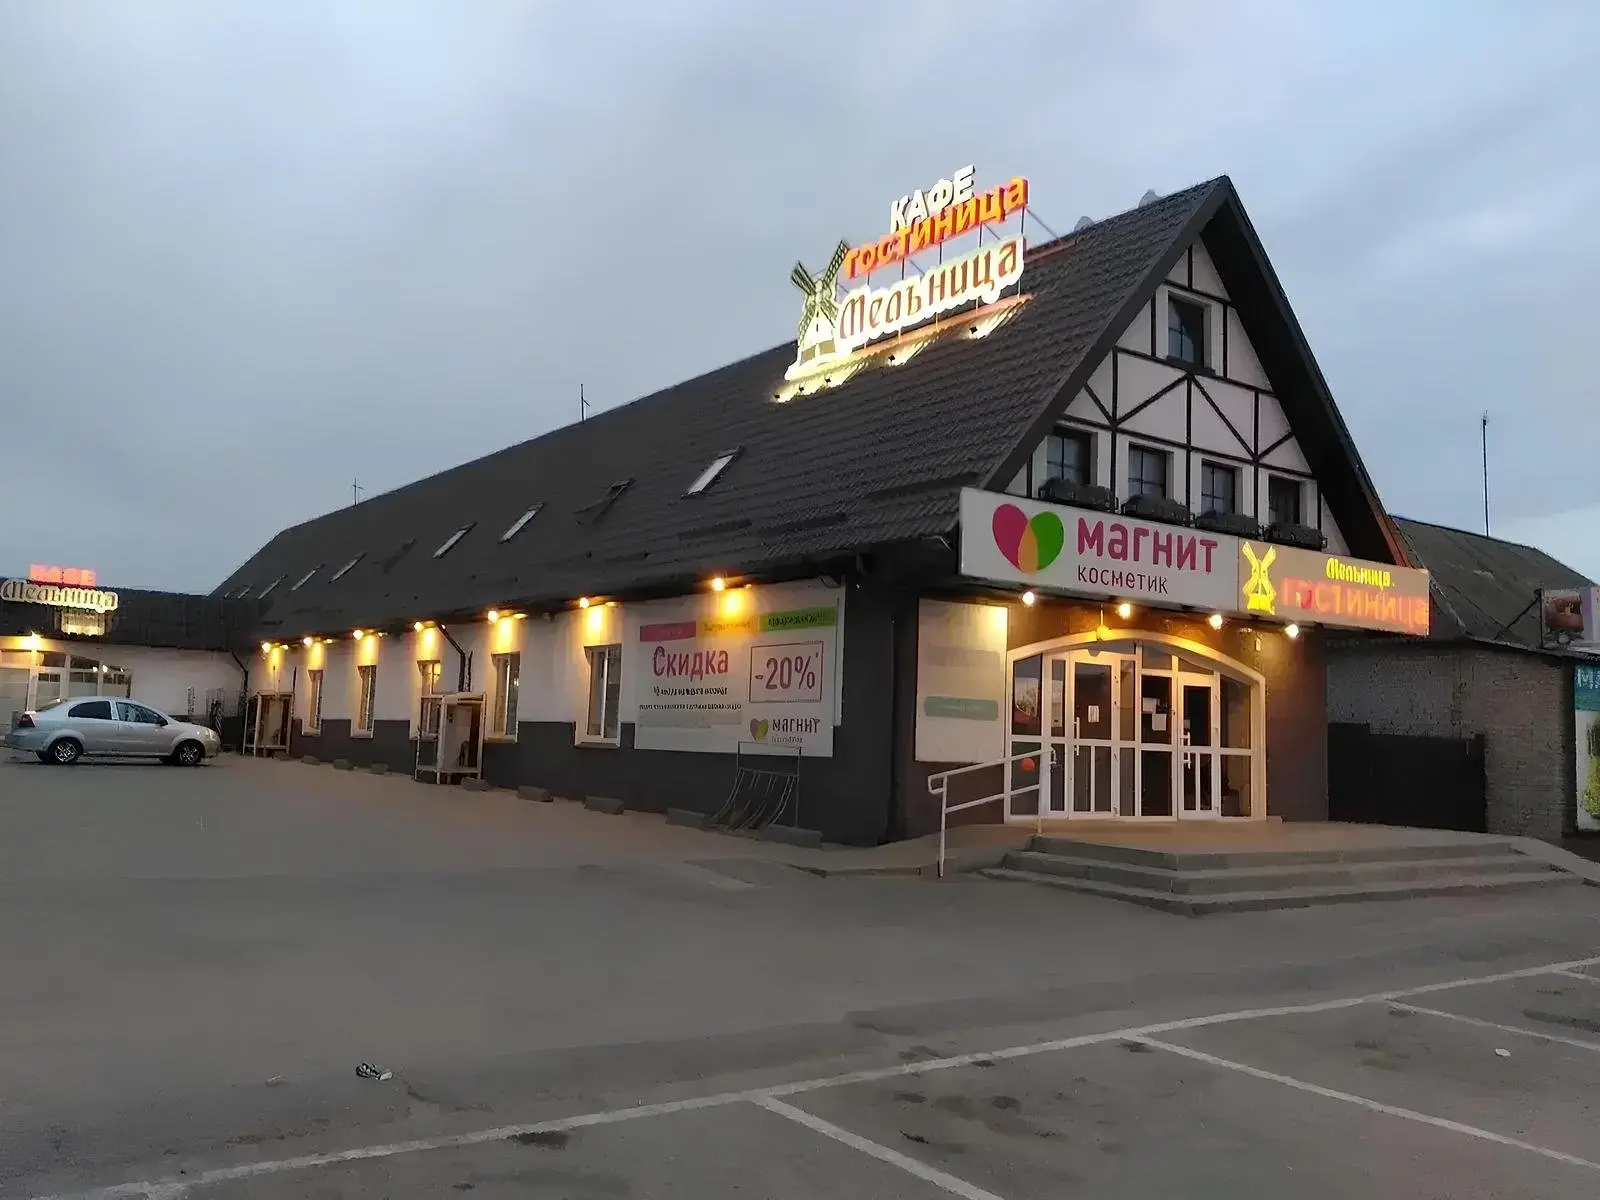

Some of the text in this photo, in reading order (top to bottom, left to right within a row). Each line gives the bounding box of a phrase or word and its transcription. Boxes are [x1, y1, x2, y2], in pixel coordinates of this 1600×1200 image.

[890, 164, 976, 234] КАФЕ
[839, 239, 1018, 339] Мельница
[1078, 564, 1168, 594] косметик
[653, 646, 729, 681] Скидка
